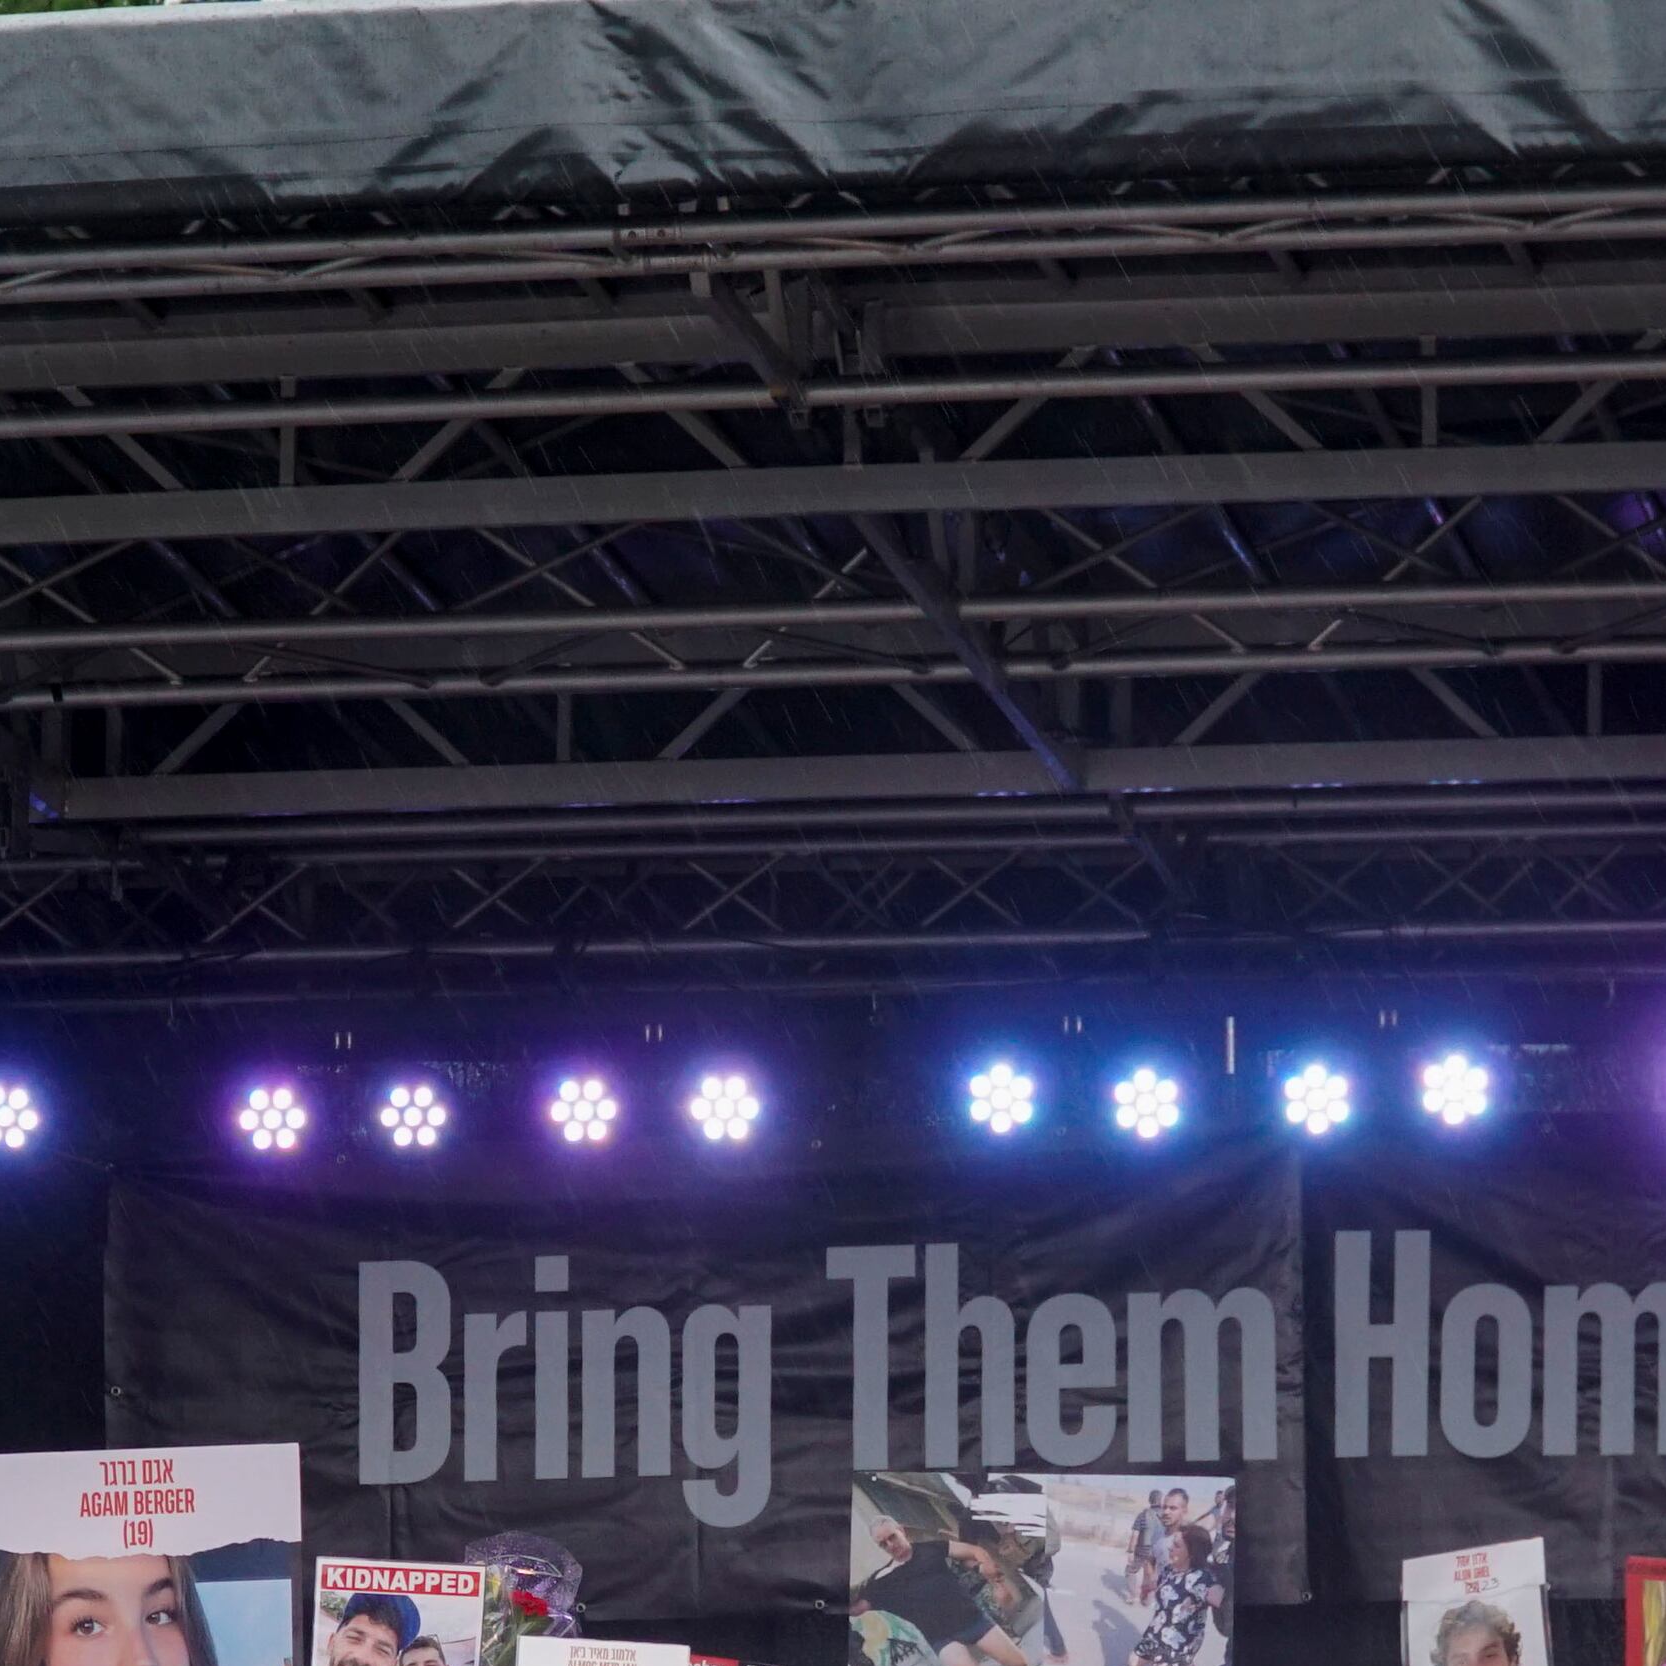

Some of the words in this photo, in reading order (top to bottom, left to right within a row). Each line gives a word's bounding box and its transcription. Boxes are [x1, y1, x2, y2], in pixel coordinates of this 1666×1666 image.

[358, 1255, 771, 1527] Bring
[825, 1242, 1277, 1472] Them
[99, 1460, 138, 1486] ברגר
[142, 1458, 175, 1484] אגם
[80, 1491, 129, 1518] AGAM
[134, 1488, 196, 1516] BERGER
[123, 1520, 154, 1549] (19)
[326, 1567, 475, 1595] KIDNAPPED
